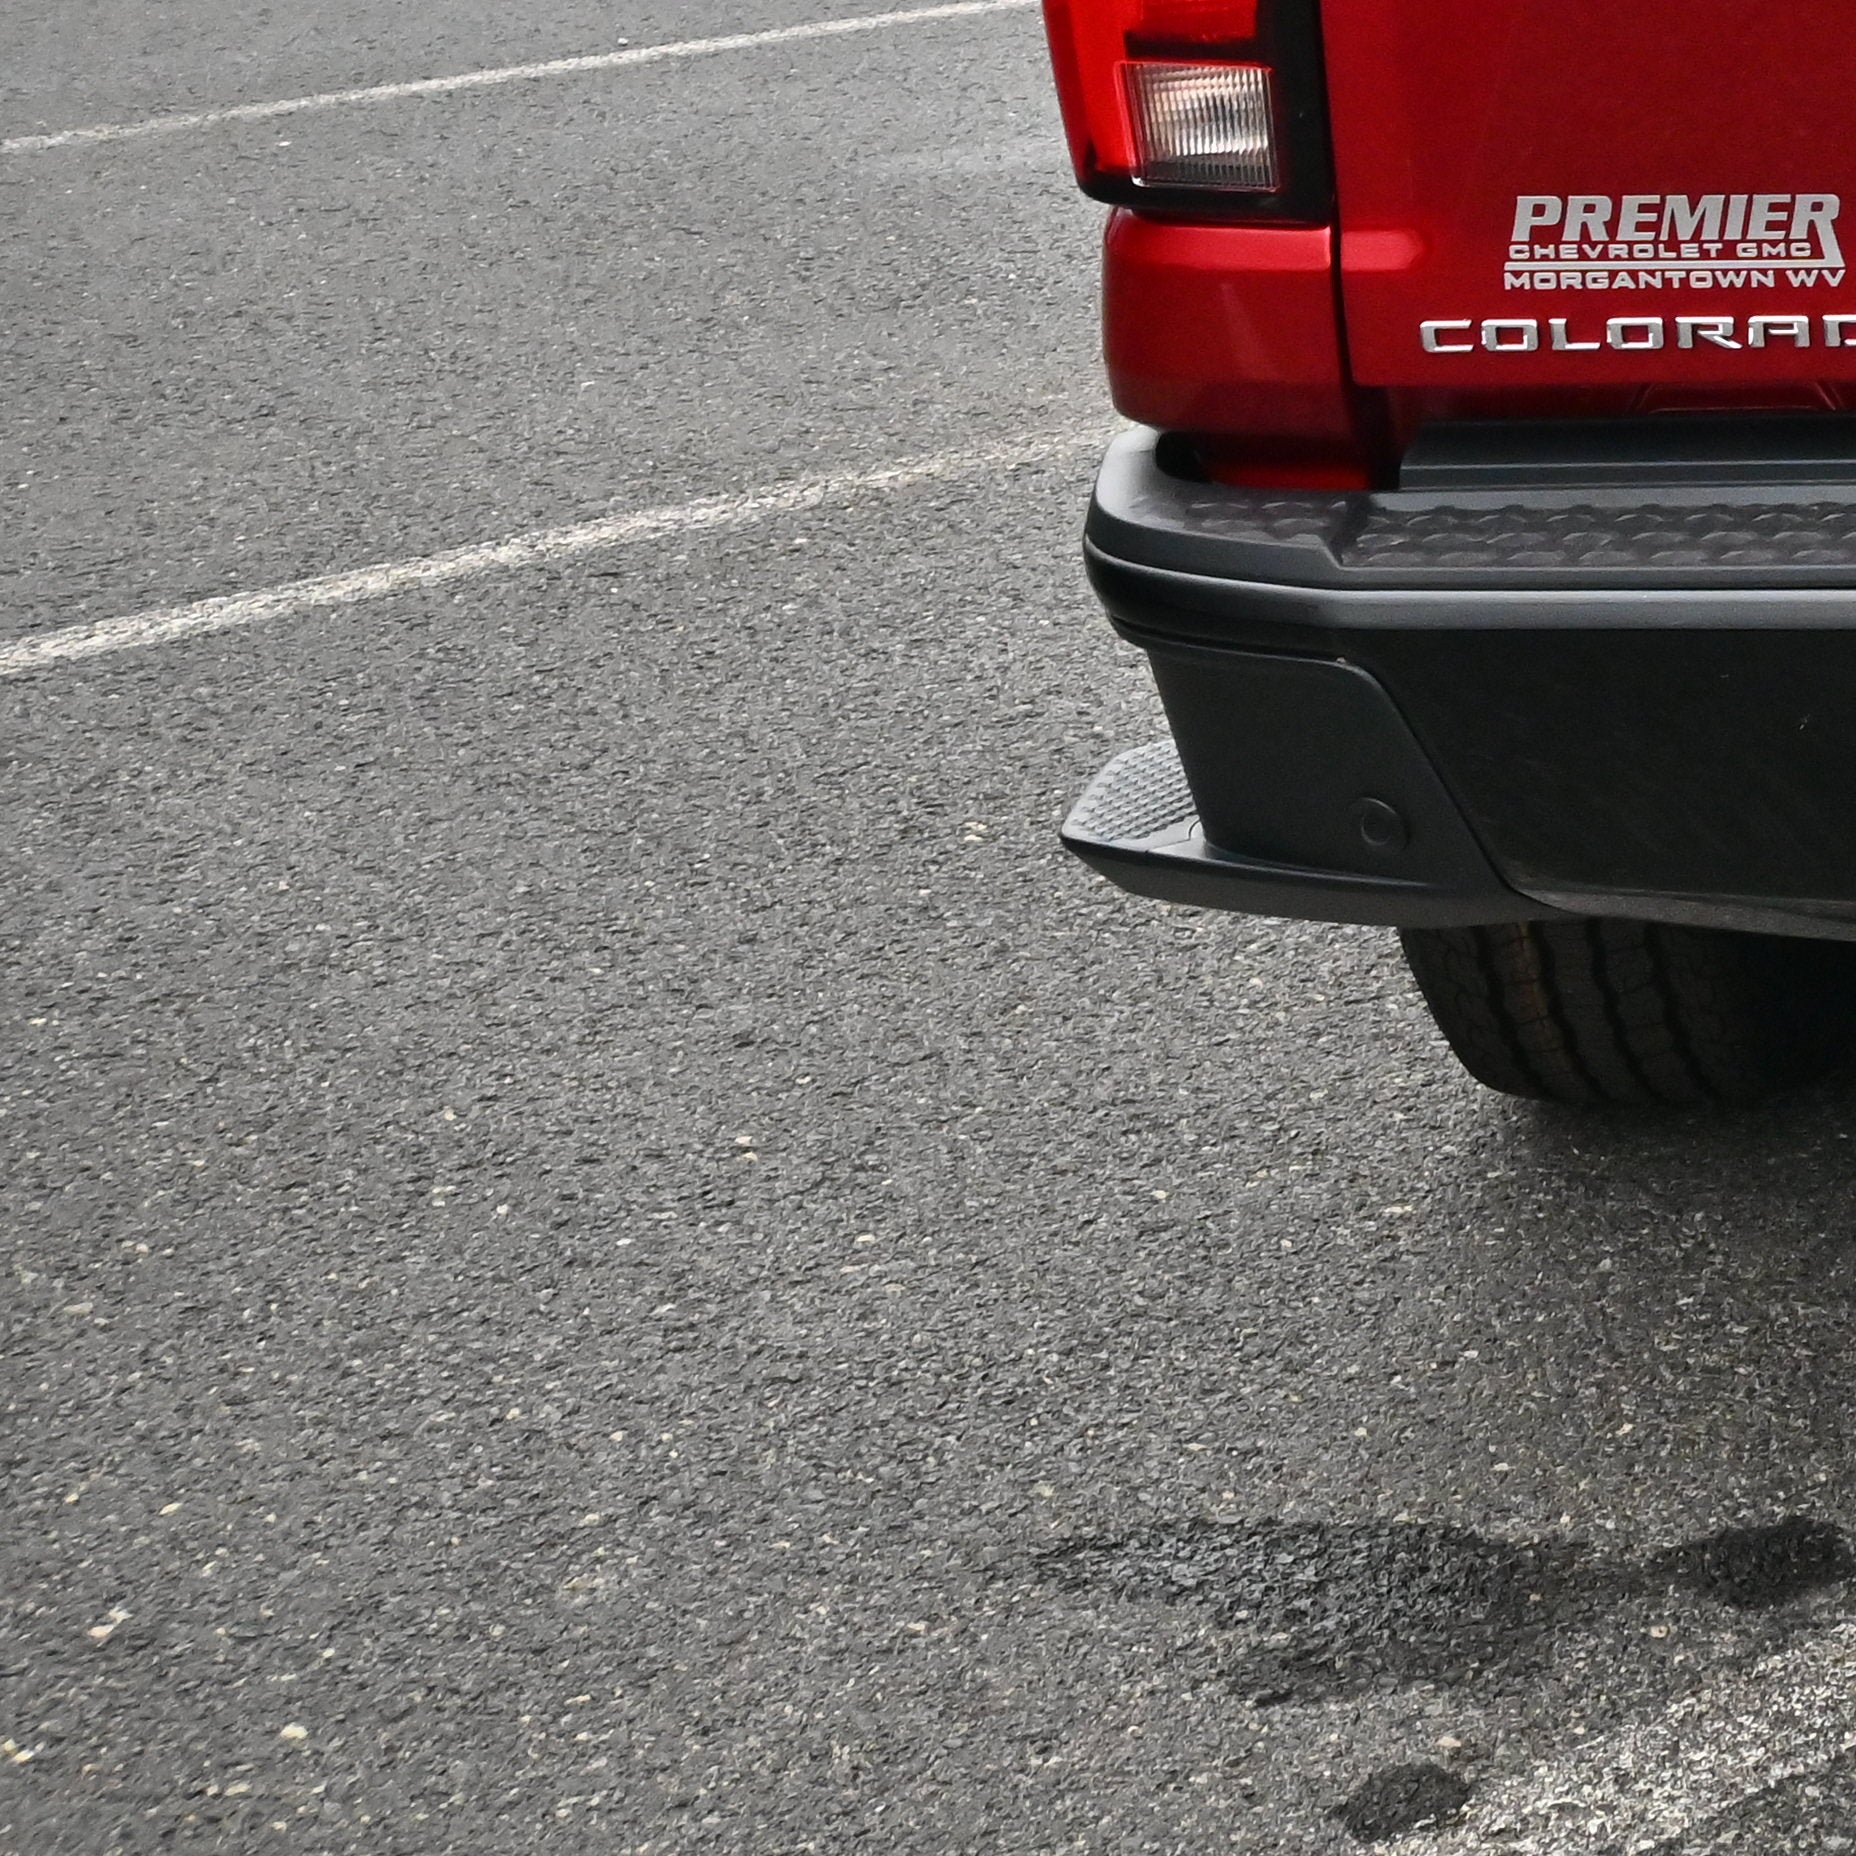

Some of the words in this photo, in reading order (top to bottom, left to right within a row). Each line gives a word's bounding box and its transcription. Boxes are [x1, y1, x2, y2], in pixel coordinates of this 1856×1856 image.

[1510, 193, 1845, 266] PREMIER
[1509, 243, 1724, 260] CHEVROLET
[1736, 242, 1812, 258] GMC
[1503, 270, 1776, 290] MORGANTOWN
[1788, 269, 1846, 288] WV
